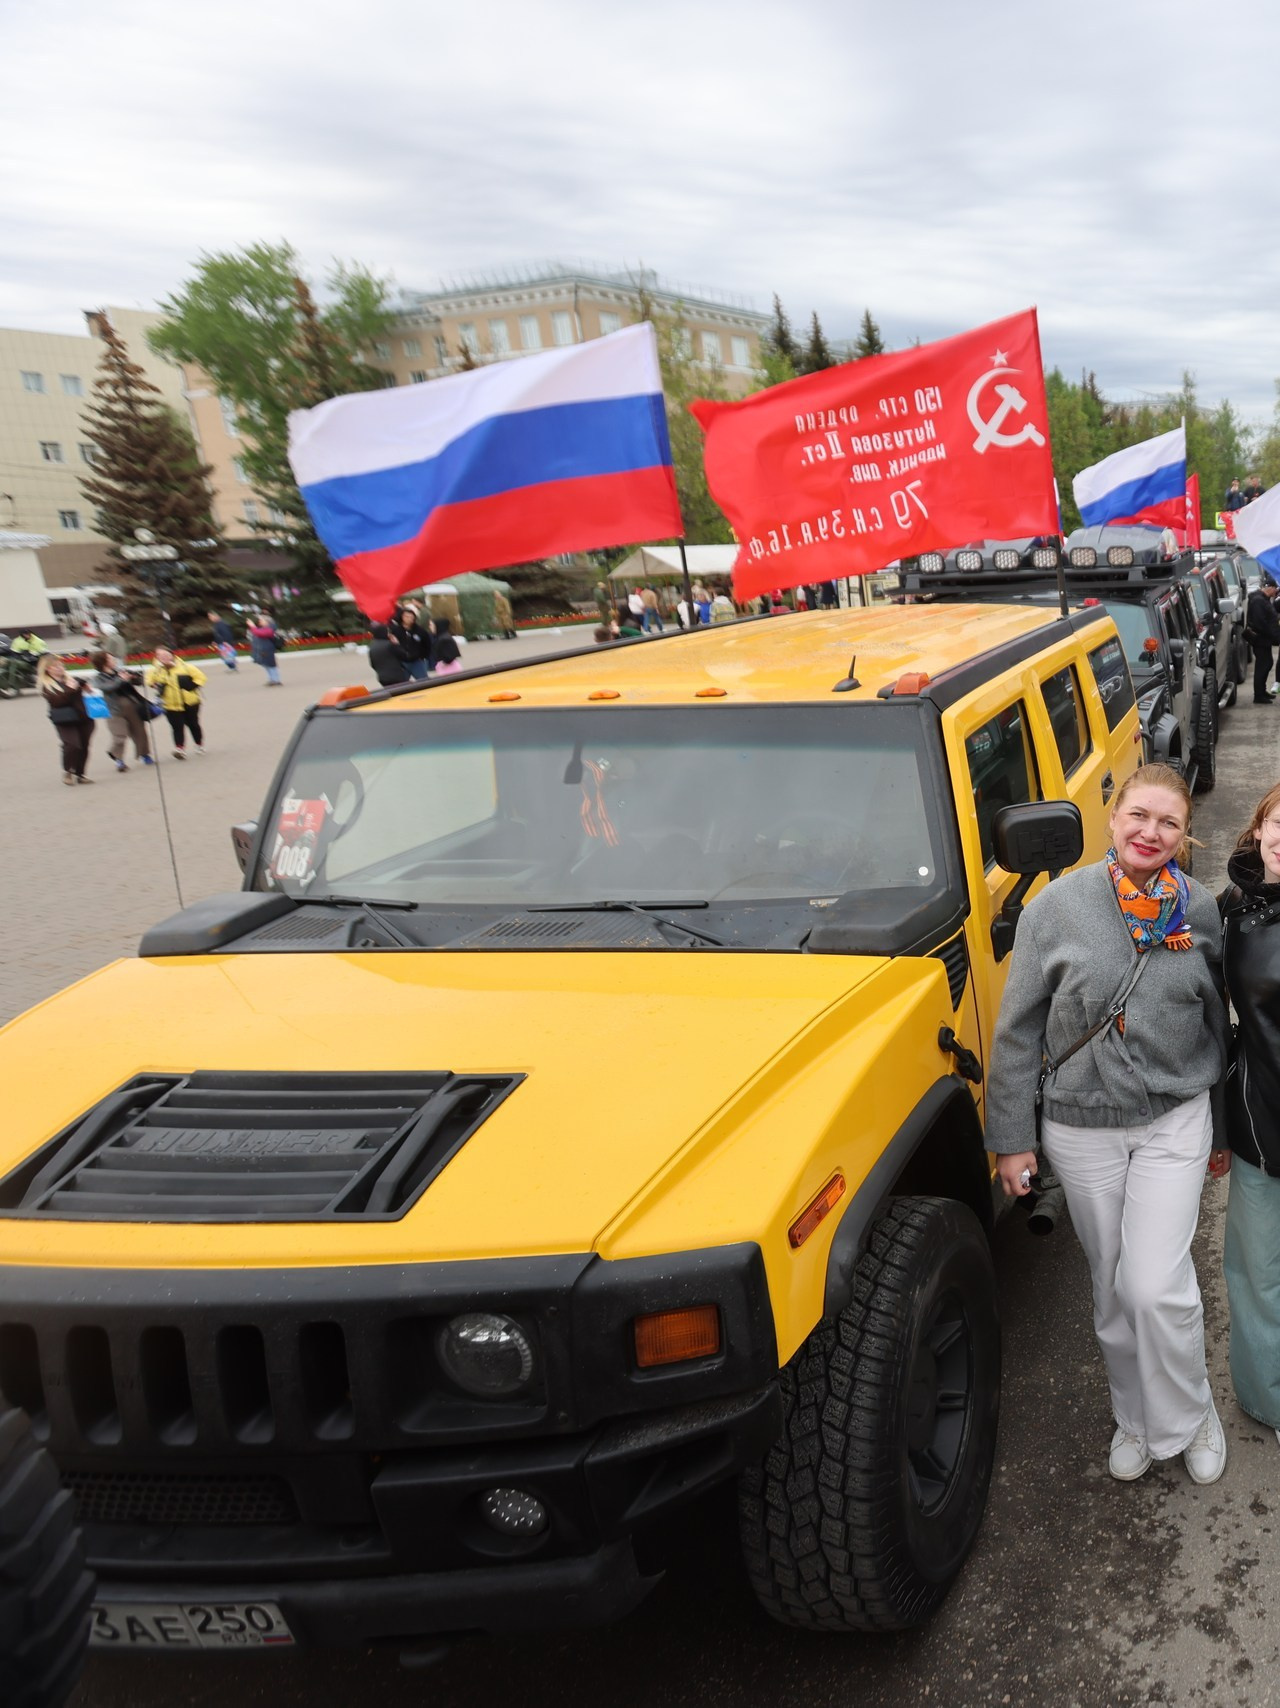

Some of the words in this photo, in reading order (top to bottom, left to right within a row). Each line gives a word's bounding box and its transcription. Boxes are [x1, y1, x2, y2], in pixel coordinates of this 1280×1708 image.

[276, 845, 311, 878] 008
[147, 1130, 350, 1153] HUMMER
[188, 1604, 275, 1634] 250
